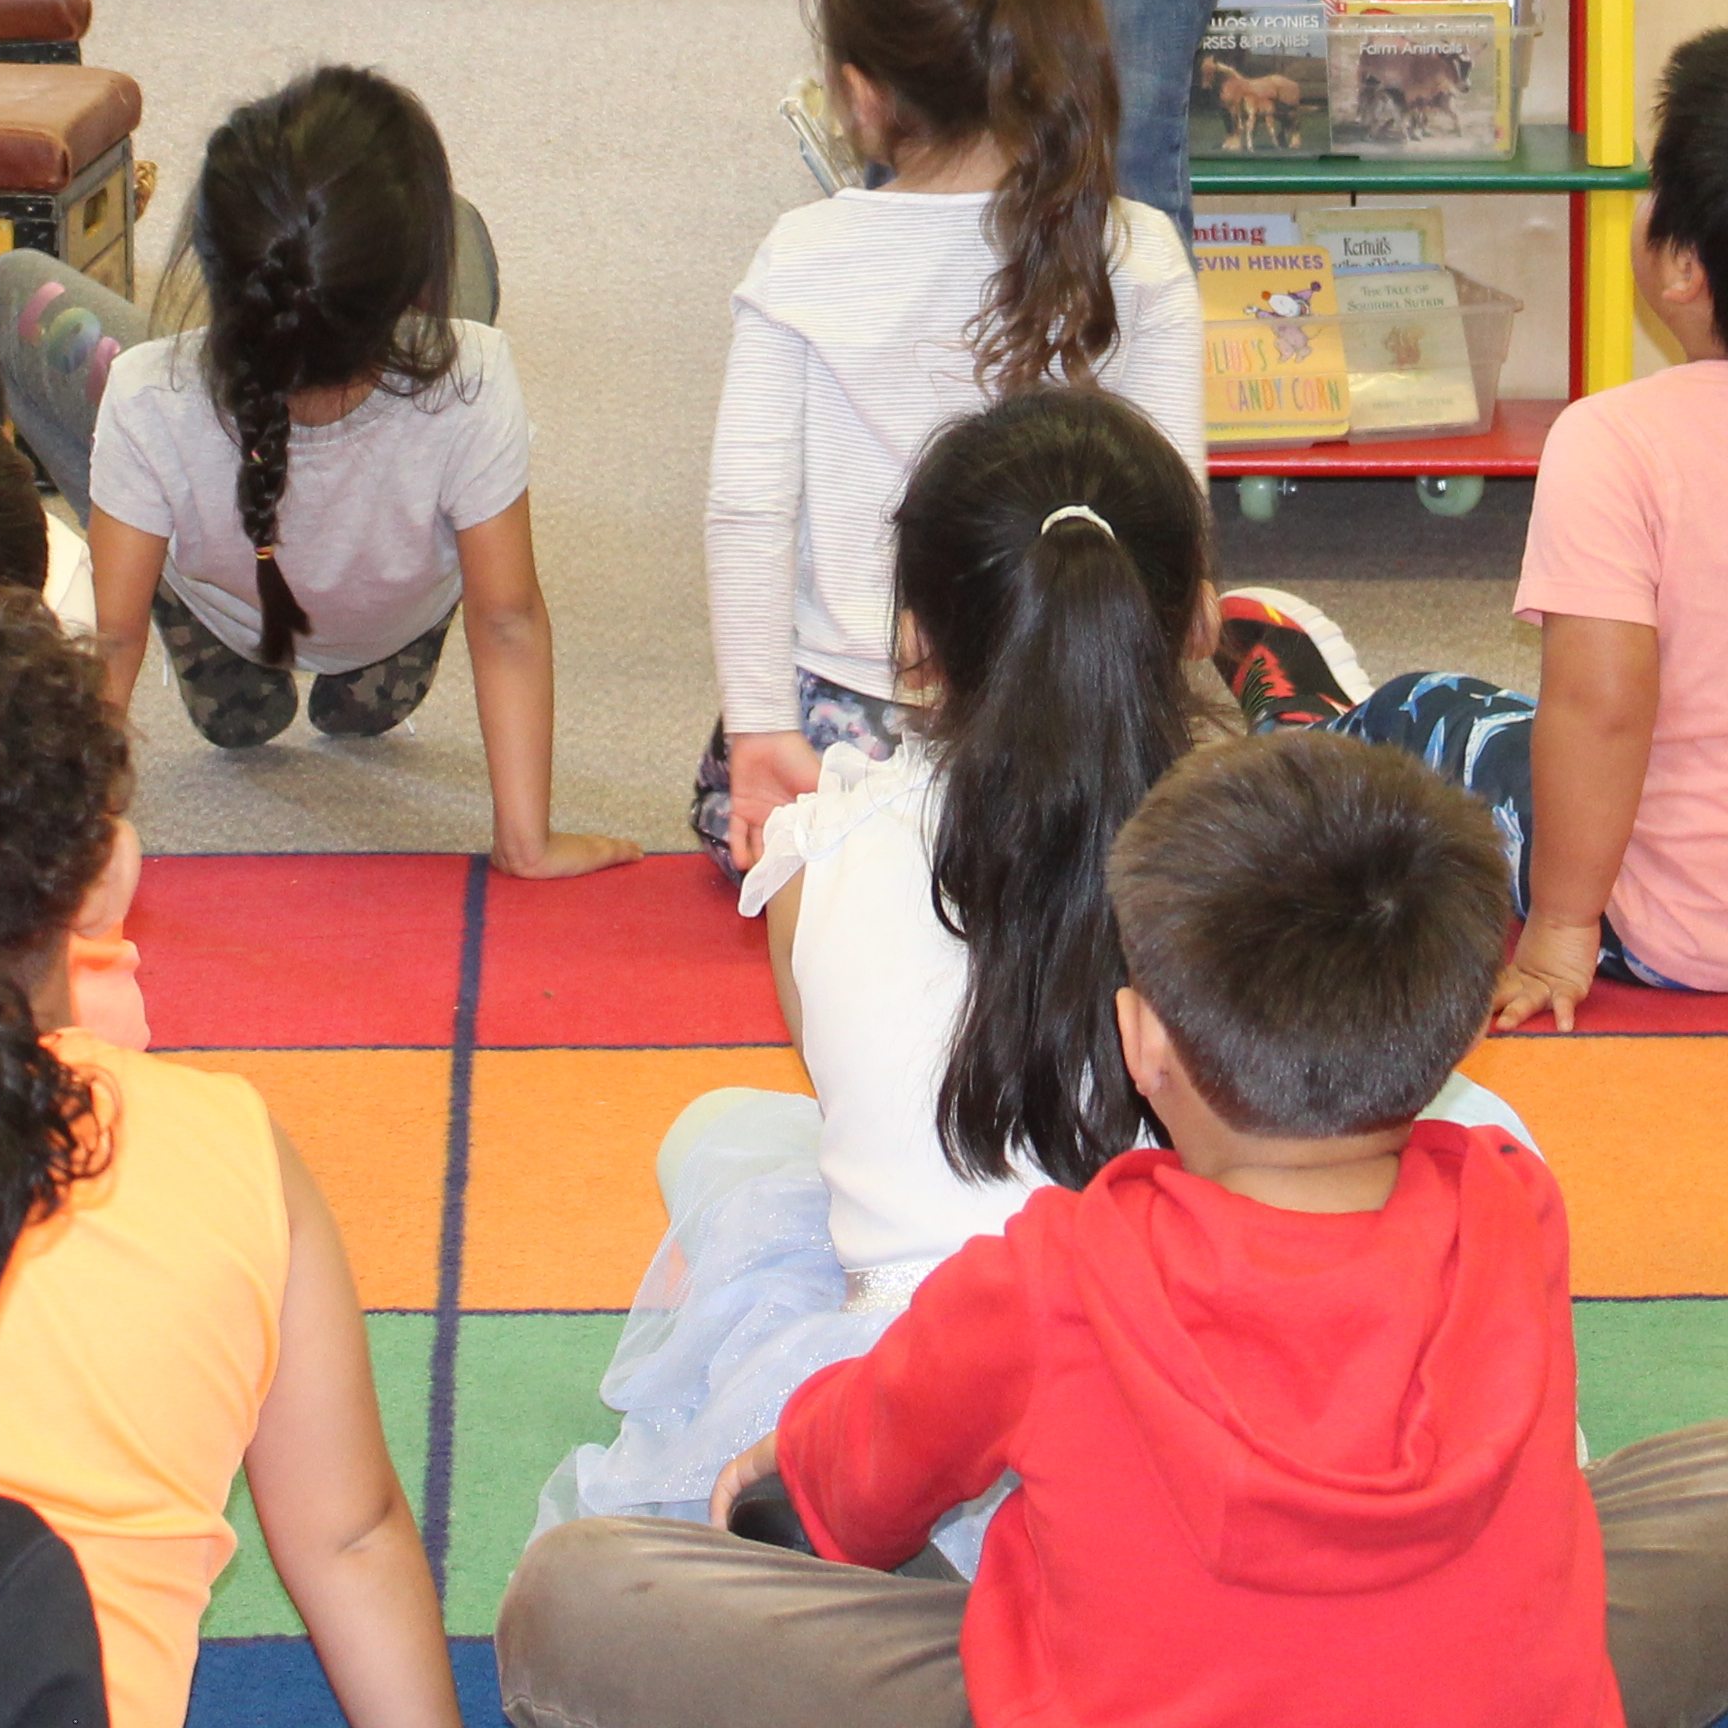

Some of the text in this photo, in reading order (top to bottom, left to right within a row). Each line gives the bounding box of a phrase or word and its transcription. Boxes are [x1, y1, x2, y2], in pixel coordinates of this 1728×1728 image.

[1249, 16, 1261, 29] Y
[1264, 15, 1319, 29] PONIES
[1239, 36, 1251, 49] &
[1253, 34, 1309, 48] PONIES
[1359, 42, 1463, 55] Farm Animals
[1343, 236, 1392, 256] Kermit's
[1197, 255, 1240, 271] EVIN
[1248, 254, 1324, 270] HENKES
[1360, 284, 1429, 297] THE TALE OF
[1347, 298, 1444, 312] SQUIRREL NUTKIN
[1205, 338, 1268, 374] ULIUS'S
[1226, 380, 1283, 413] CANDY
[1292, 378, 1342, 412] CORN
